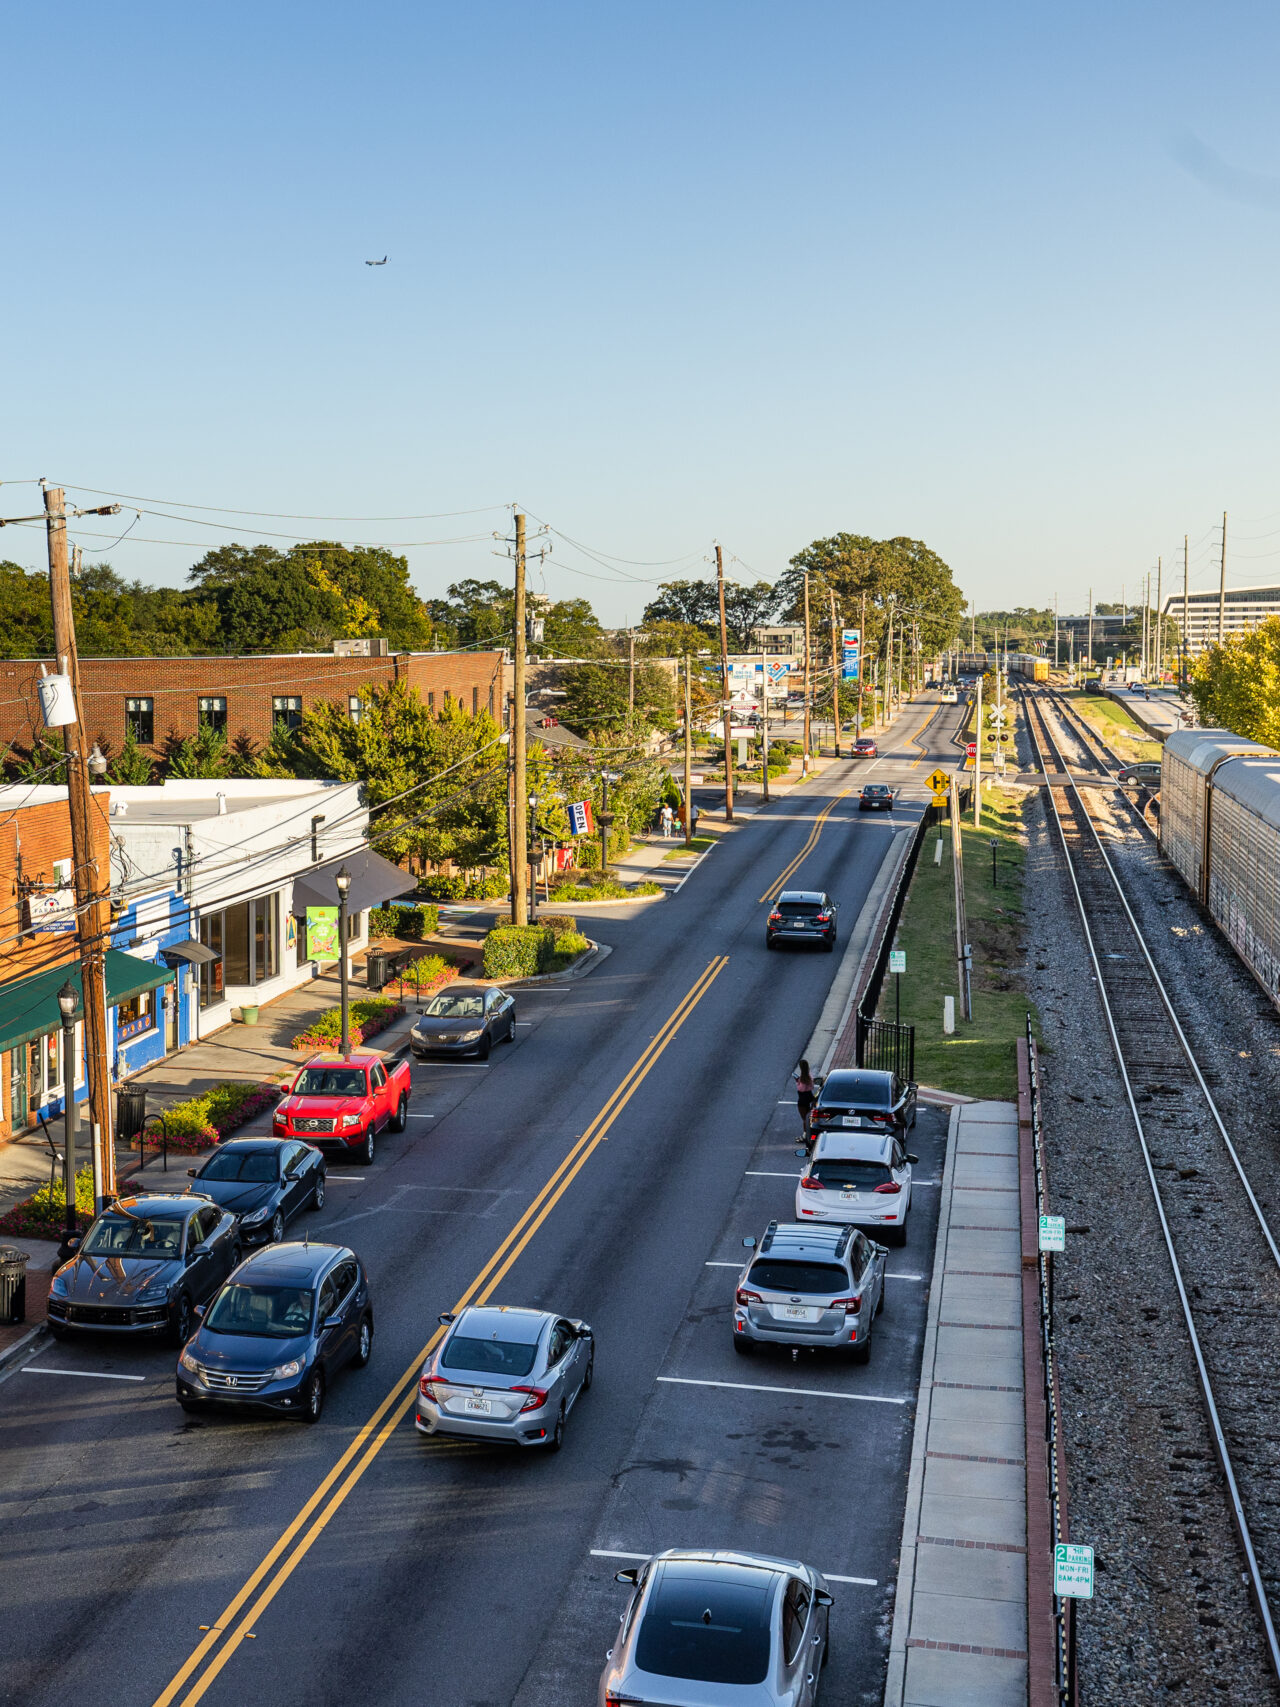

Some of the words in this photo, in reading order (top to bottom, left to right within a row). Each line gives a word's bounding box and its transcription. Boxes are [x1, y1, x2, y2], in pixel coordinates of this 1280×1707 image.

[575, 804, 586, 829] OPEN
[1057, 1547, 1066, 1560] 2
[1068, 1554, 1091, 1562] PARKING
[1059, 1564, 1089, 1573] MON-FRI
[1057, 1575, 1090, 1583] 8AM-4PM
